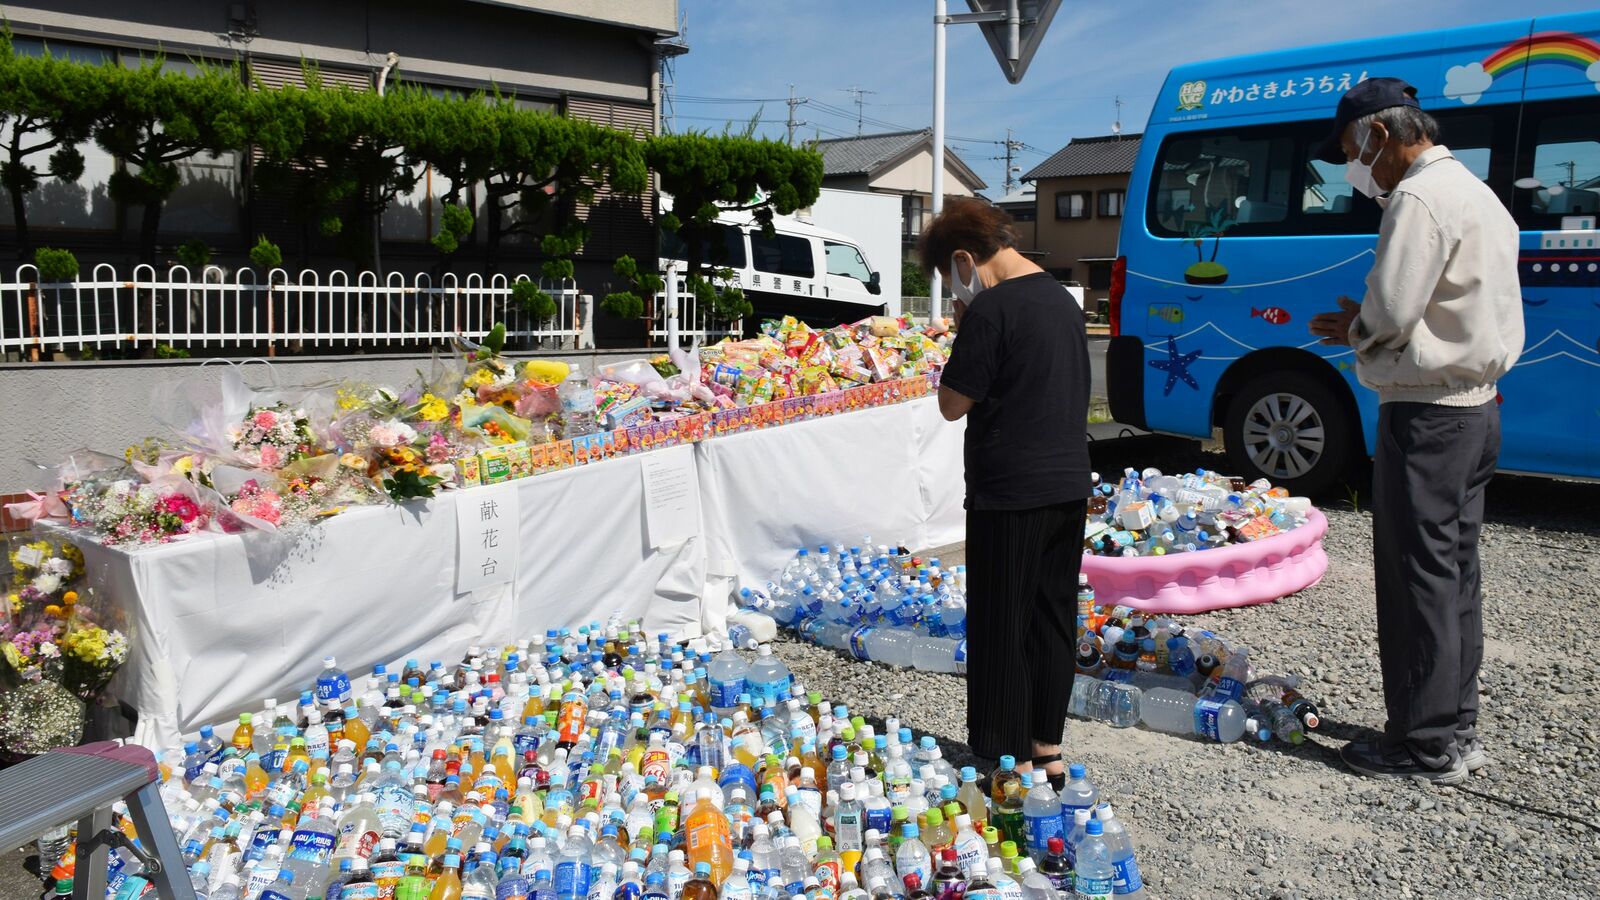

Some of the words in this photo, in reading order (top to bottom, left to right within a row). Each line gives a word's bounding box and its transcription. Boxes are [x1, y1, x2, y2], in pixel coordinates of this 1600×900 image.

[480, 500, 499, 577] 献花台
[294, 833, 332, 847] AQUARIUS
